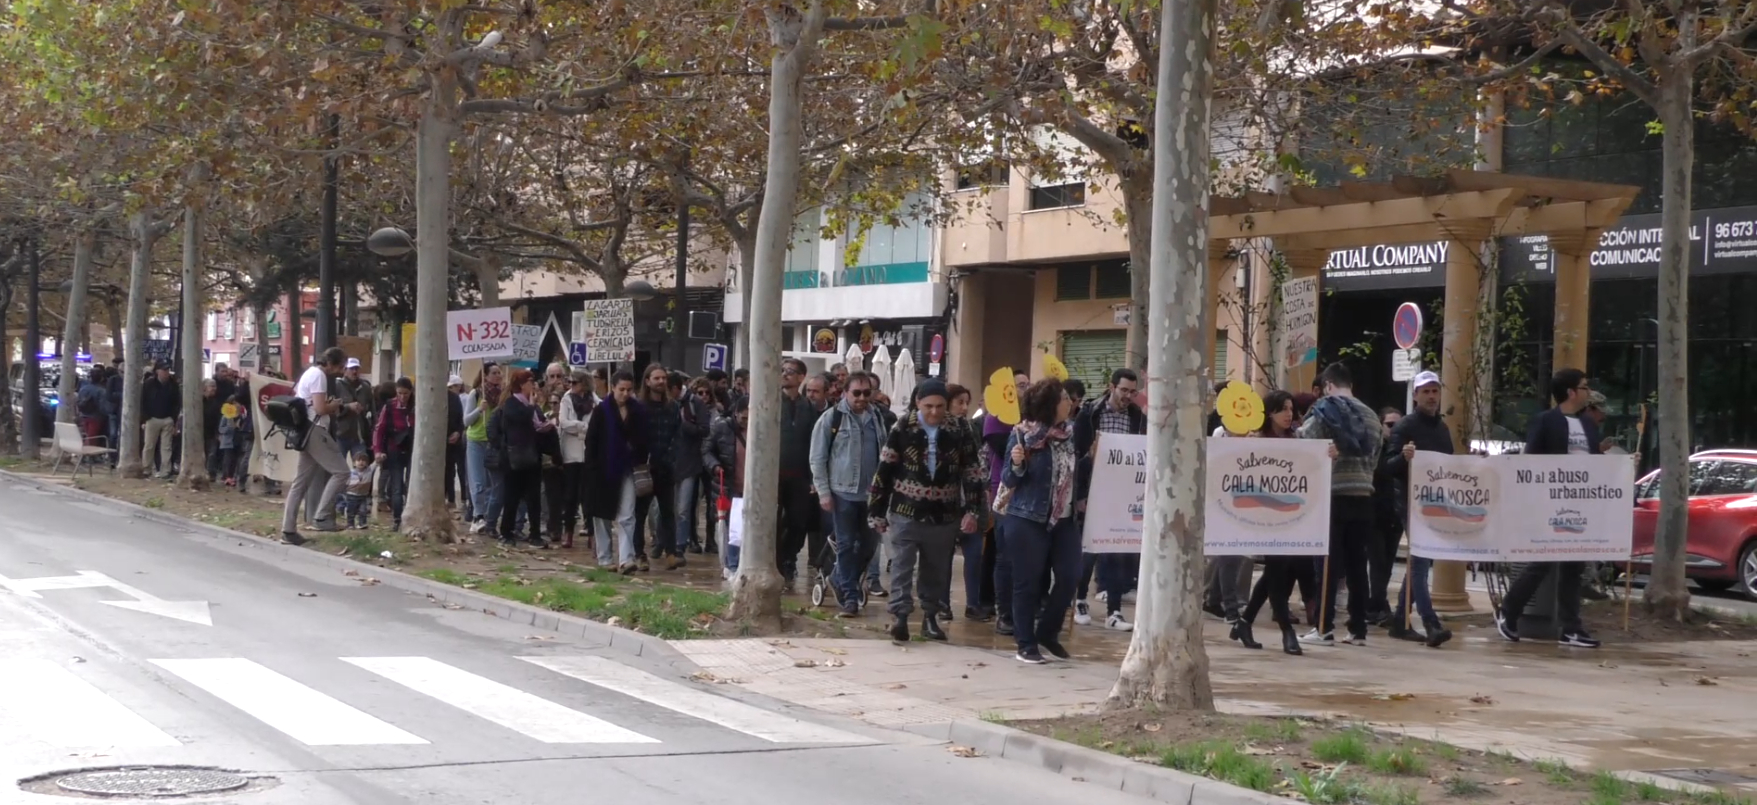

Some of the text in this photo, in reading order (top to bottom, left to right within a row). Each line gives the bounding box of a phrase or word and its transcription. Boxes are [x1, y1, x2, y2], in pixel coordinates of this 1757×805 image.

[1599, 227, 1636, 246] CCIÓN
[1715, 223, 1730, 238] 96
[1731, 221, 1753, 237] 673
[1326, 240, 1449, 269] RTUAL COMPANY
[1590, 247, 1662, 266] COMUNICAC
[1284, 279, 1317, 298] NUESTRA
[586, 299, 633, 310] LAGARTO
[1285, 298, 1306, 315] COSTA
[511, 326, 539, 337] STRO
[595, 327, 630, 337] ERIZOS
[462, 343, 507, 354] COLAPSADA
[522, 340, 538, 349] DE
[513, 349, 536, 358] RTAD
[705, 347, 720, 369] P
[1107, 449, 1123, 465] NO
[1125, 453, 1134, 466] al
[1236, 452, 1294, 473] Salvemos
[1221, 474, 1308, 493] CALA MOSCA
[1426, 466, 1479, 487] Salvemos
[1516, 468, 1589, 484] NO al abuso
[1413, 484, 1490, 506] CALA MOSCA
